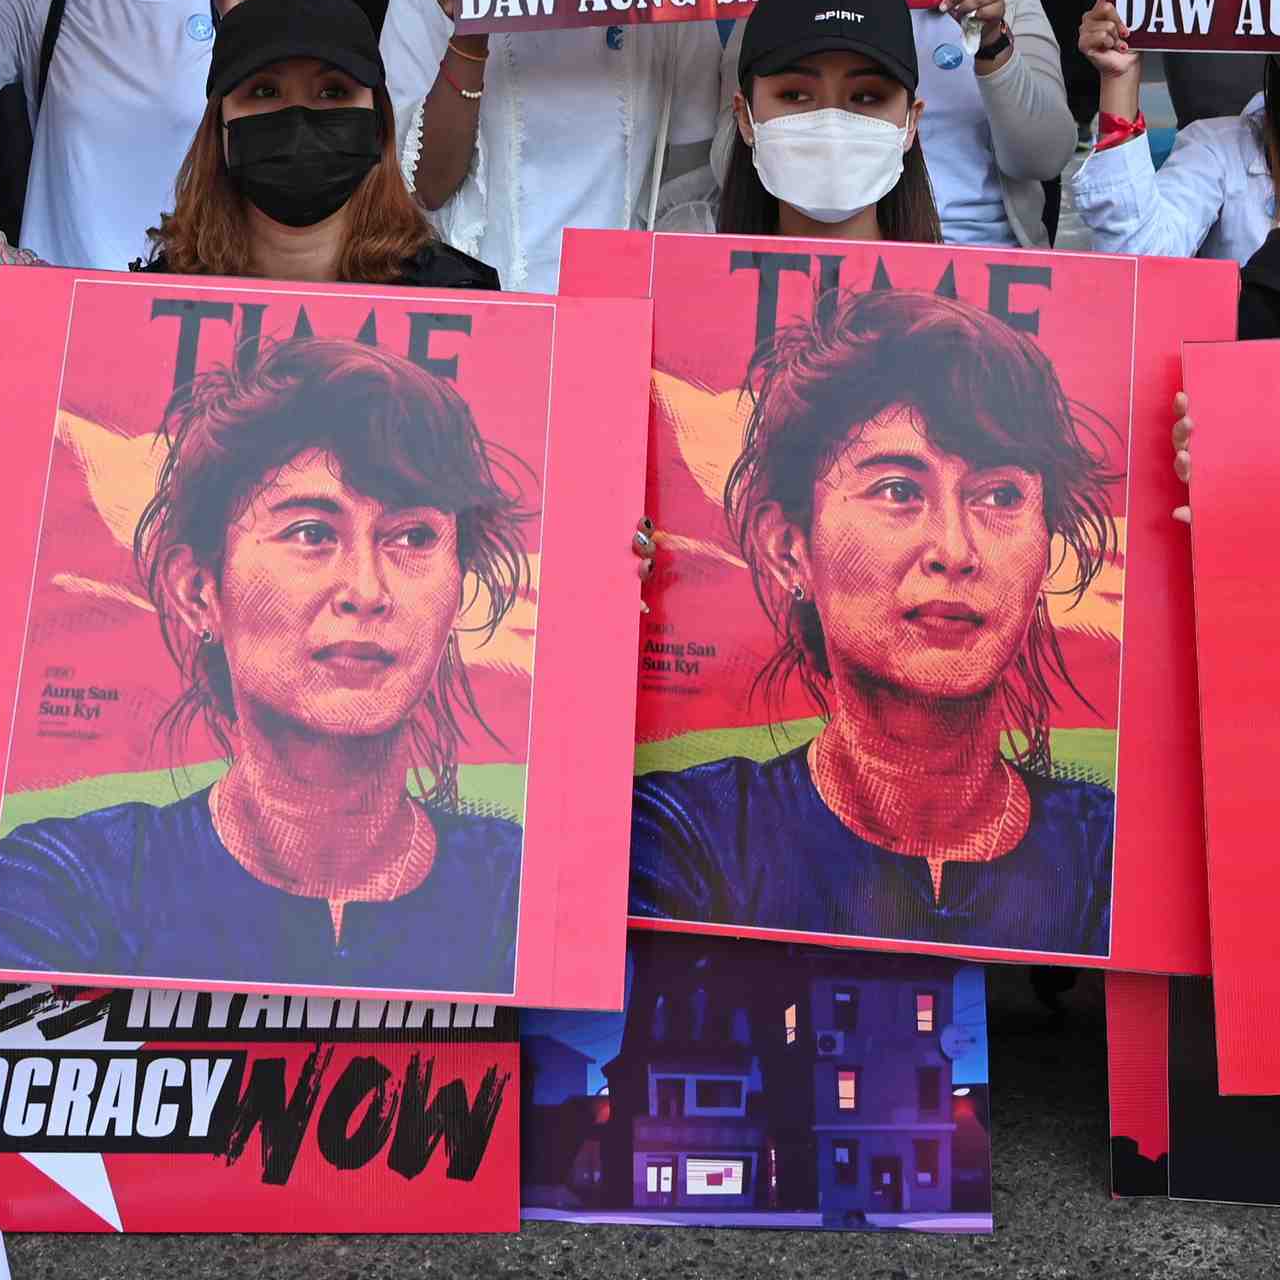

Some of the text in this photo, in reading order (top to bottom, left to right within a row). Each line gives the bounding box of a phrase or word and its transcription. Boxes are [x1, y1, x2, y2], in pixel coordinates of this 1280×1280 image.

[814, 10, 865, 23] SPIRIT
[151, 298, 473, 402] TIE
[730, 250, 1052, 355] TIE
[213, 1040, 510, 1186] NOW
